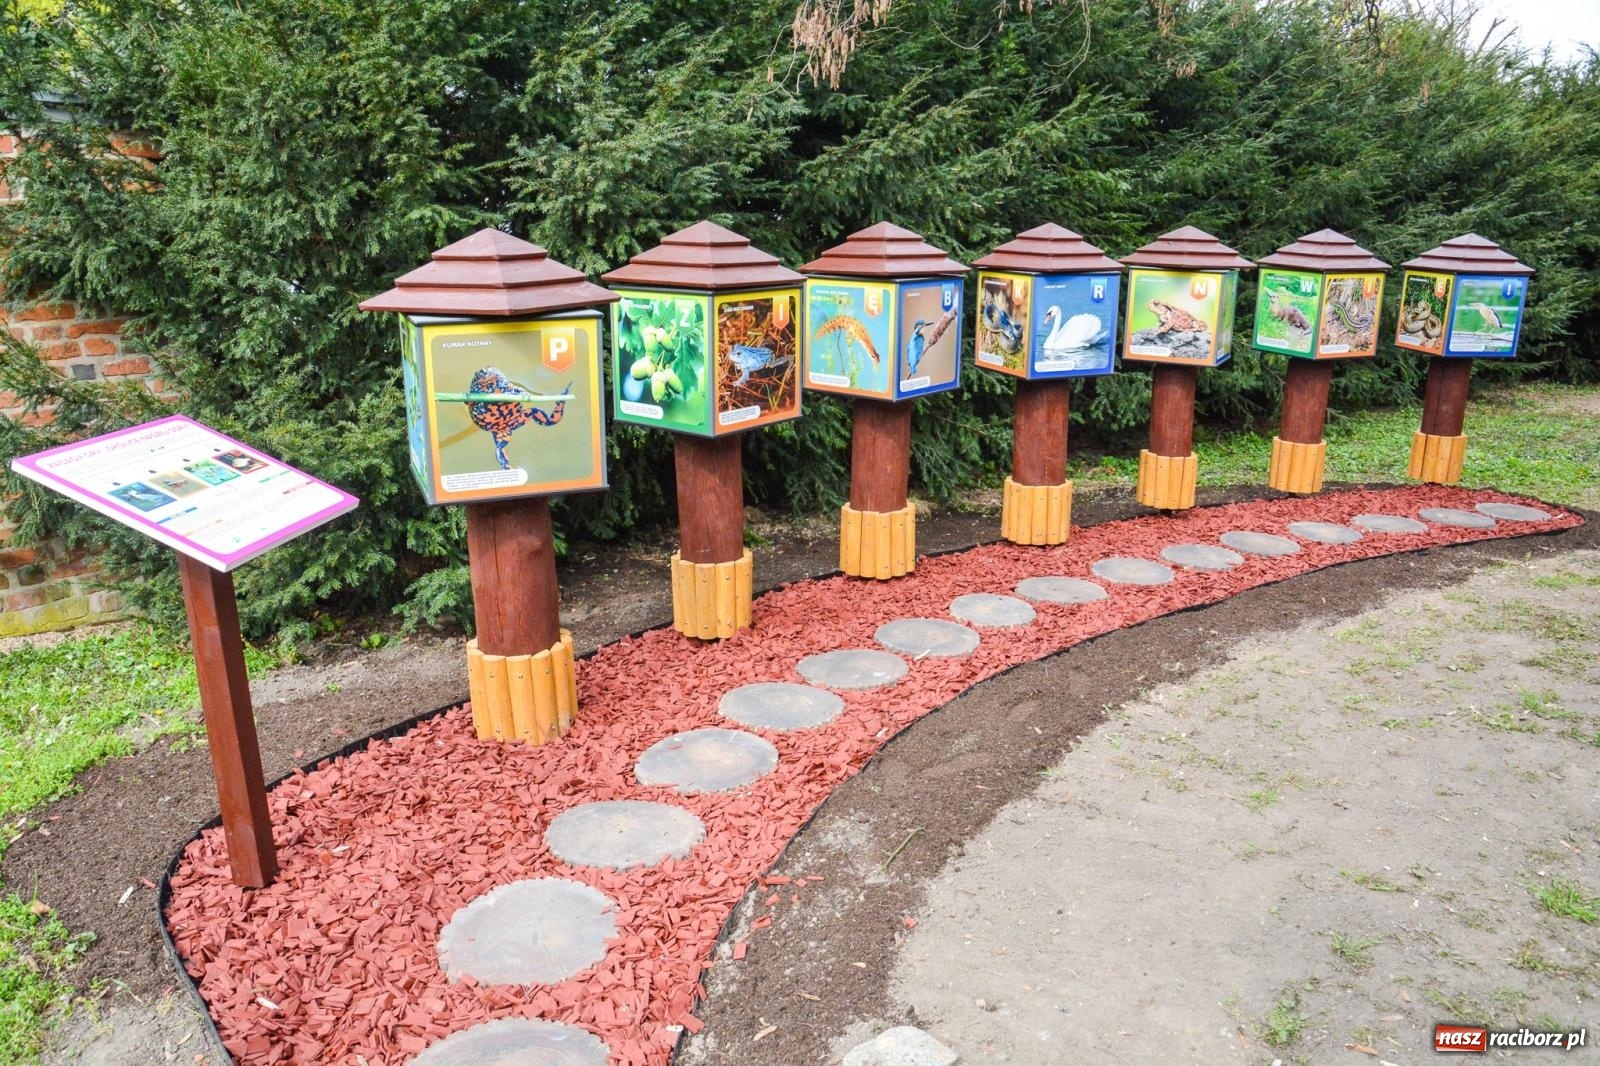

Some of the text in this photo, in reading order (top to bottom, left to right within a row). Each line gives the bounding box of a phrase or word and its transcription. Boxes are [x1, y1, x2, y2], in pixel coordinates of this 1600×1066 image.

[1093, 284, 1104, 299] R
[1194, 281, 1207, 294] N
[1301, 280, 1313, 293] W
[943, 291, 952, 306] B
[679, 308, 690, 328] Z
[549, 337, 568, 362] P
